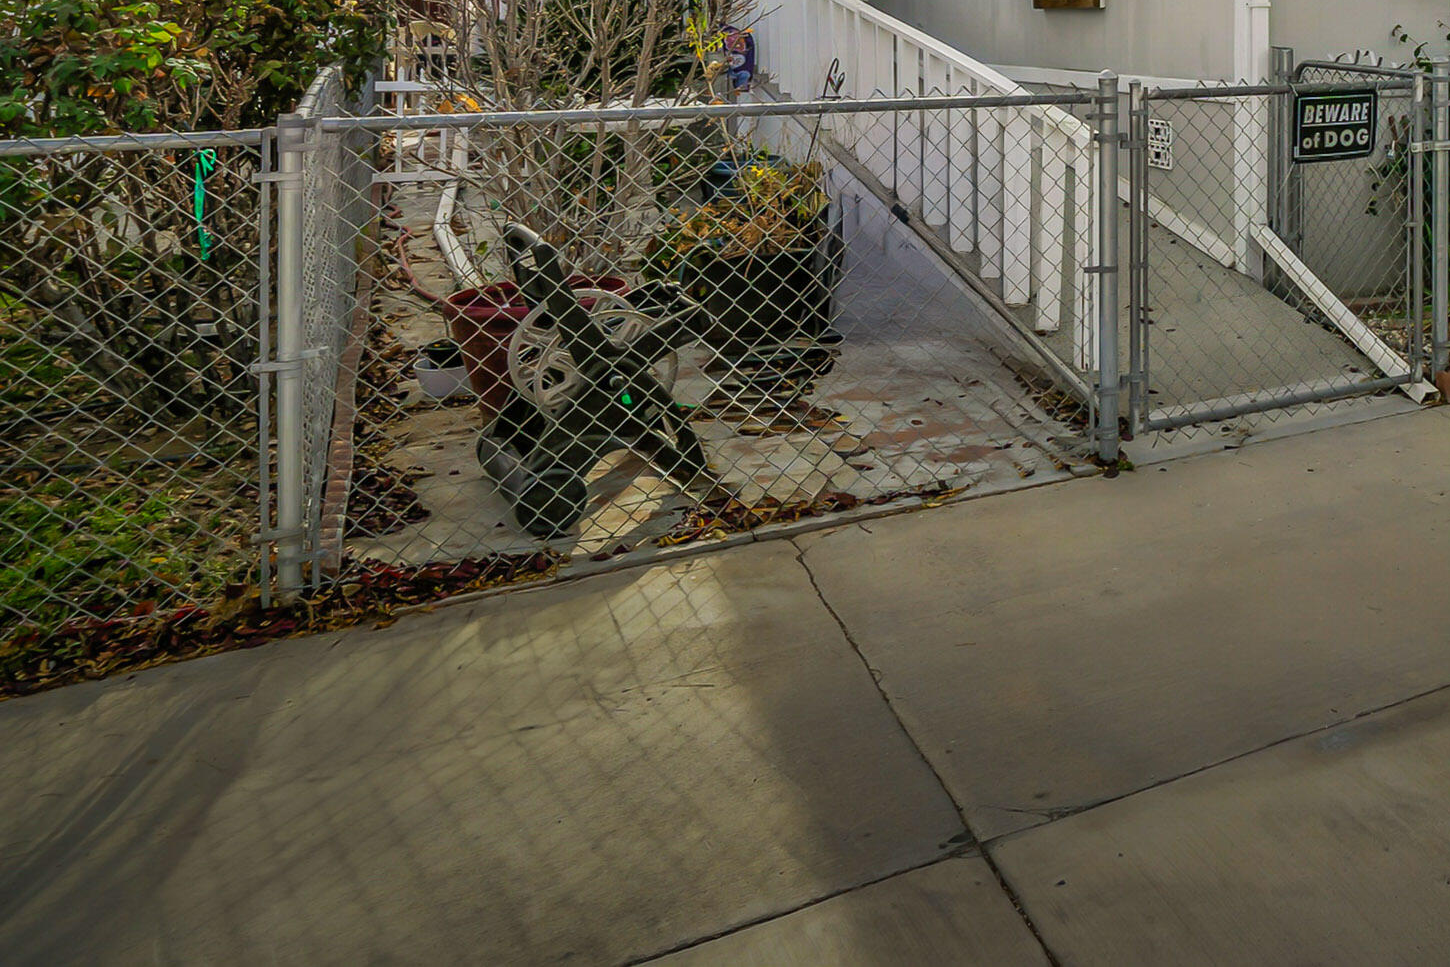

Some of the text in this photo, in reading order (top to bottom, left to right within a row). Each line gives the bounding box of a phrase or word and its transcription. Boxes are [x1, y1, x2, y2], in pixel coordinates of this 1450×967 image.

[1303, 102, 1370, 124] BEWARE
[1302, 128, 1369, 149] of DOG
